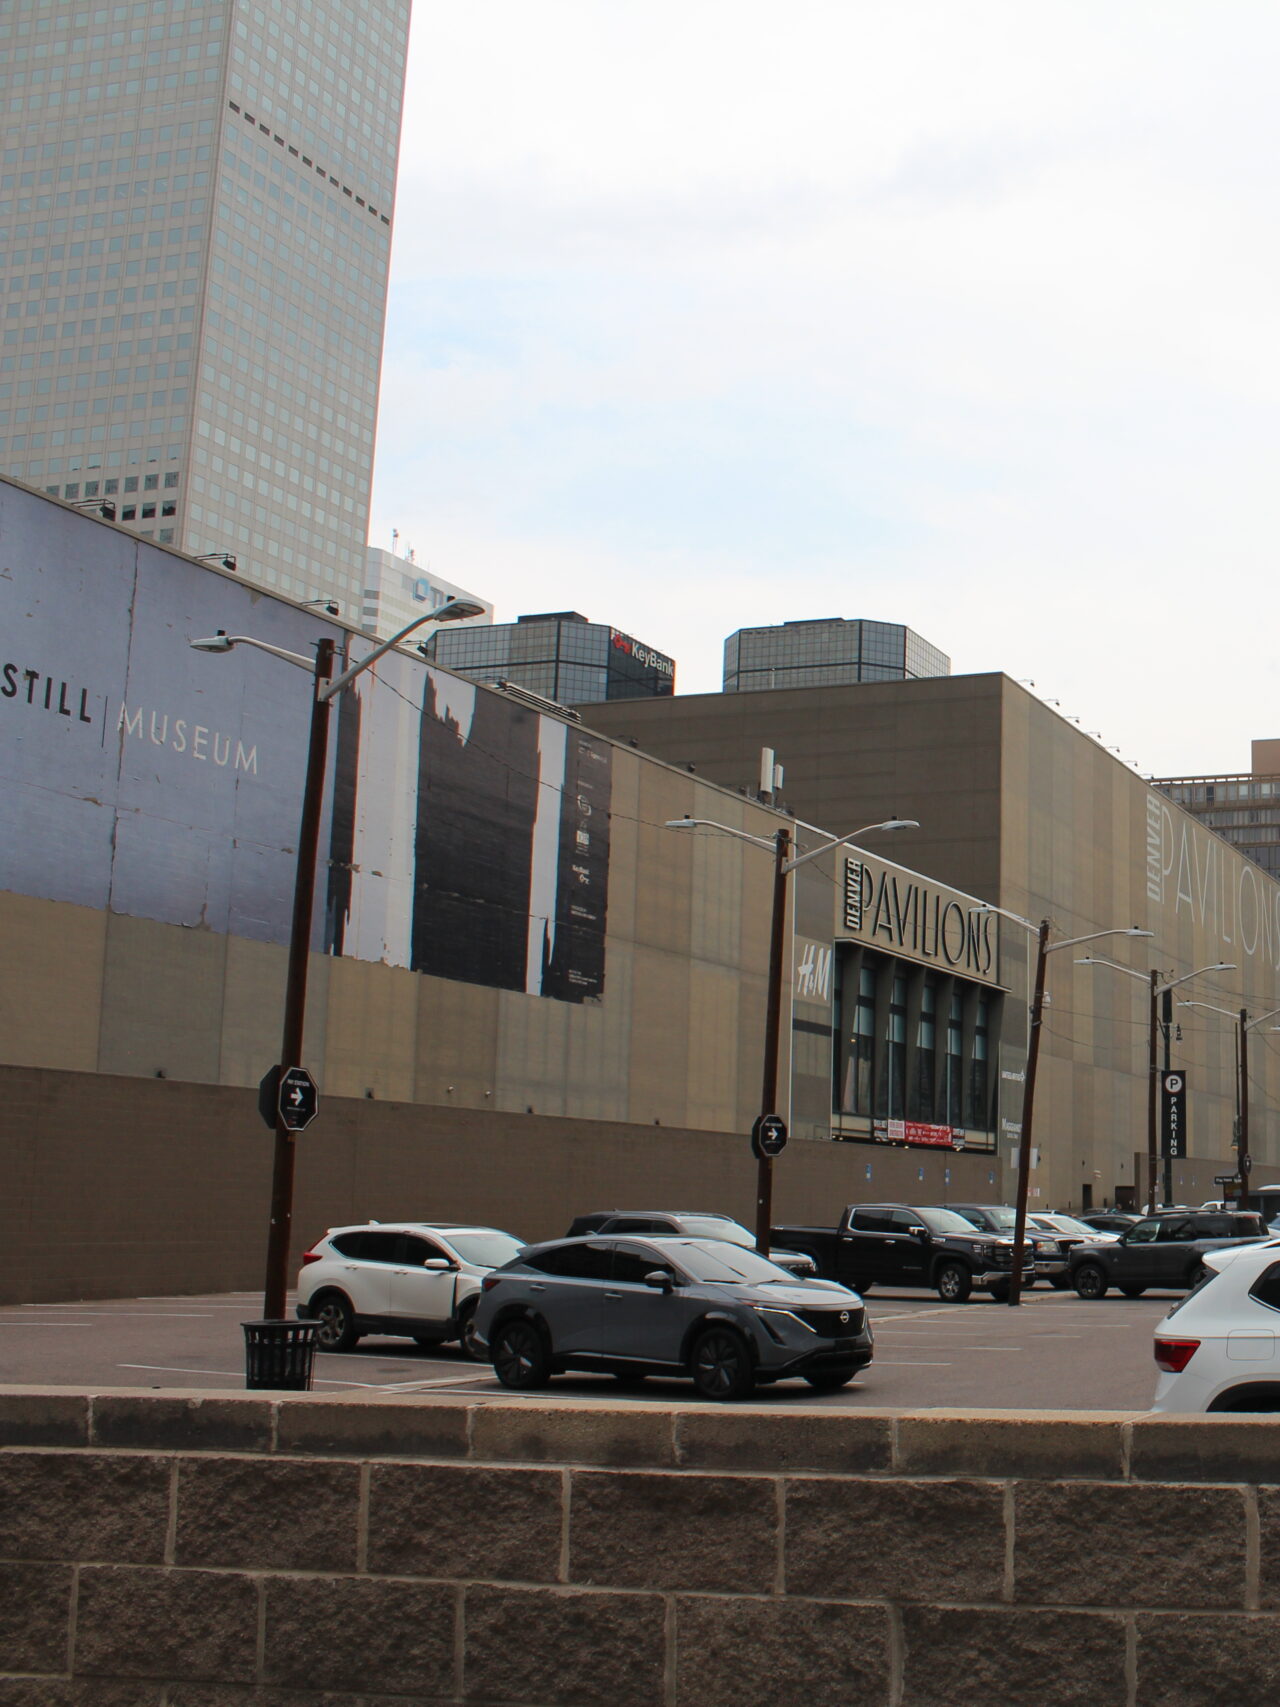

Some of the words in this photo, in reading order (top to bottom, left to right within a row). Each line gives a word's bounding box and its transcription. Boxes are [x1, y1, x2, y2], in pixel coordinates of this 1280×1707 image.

[631, 641, 674, 677] KeyBank
[1, 663, 92, 724] STILL
[116, 700, 258, 775] MUSEUM
[1147, 794, 1161, 903] DENVER
[845, 857, 863, 931] DENVER
[862, 864, 993, 975] PAVILIONS
[797, 943, 832, 1001] H&M
[1170, 1096, 1178, 1156] PARKING
